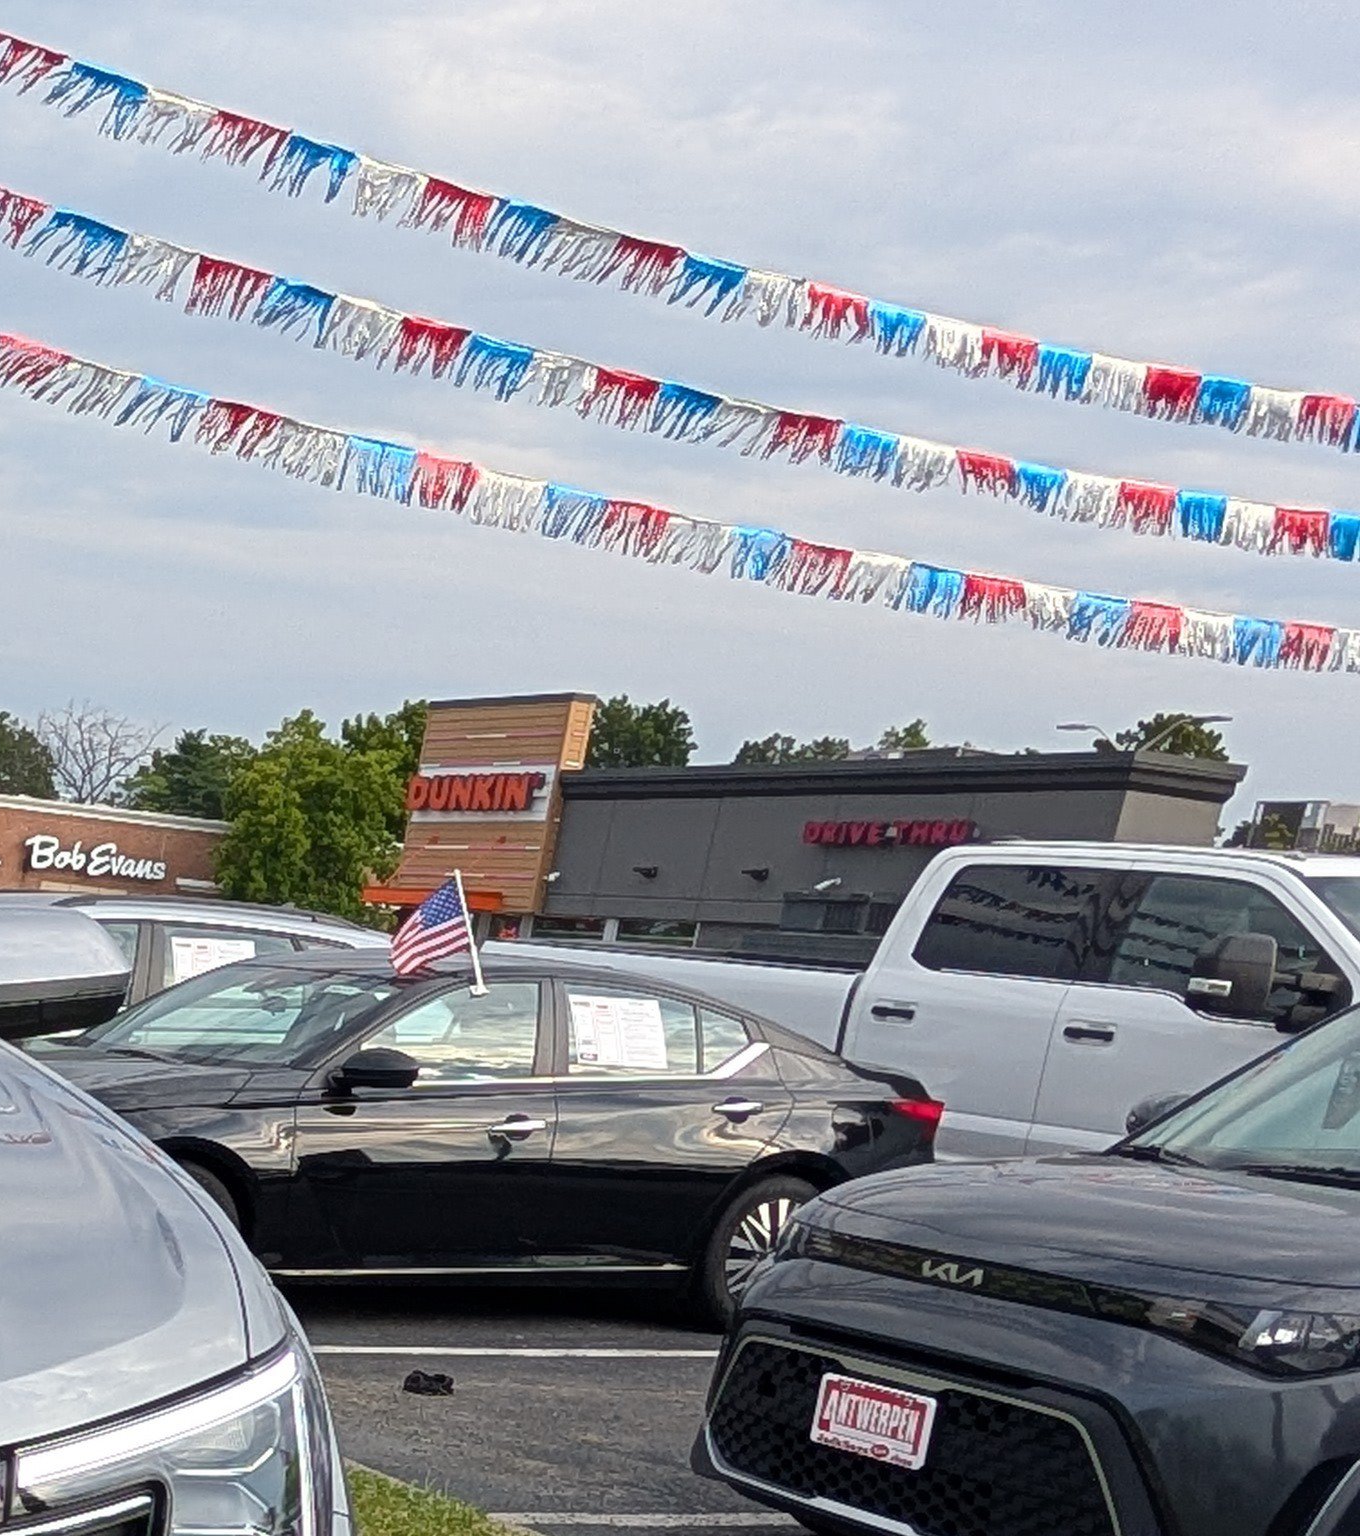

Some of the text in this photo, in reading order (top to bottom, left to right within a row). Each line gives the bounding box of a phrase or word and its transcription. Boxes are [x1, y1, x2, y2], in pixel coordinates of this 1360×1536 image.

[406, 772, 546, 811] DUNKIN'
[803, 818, 973, 846] DRIVE THRU
[25, 834, 167, 880] Bob Evans
[821, 1388, 921, 1444] ANTWERPEN
